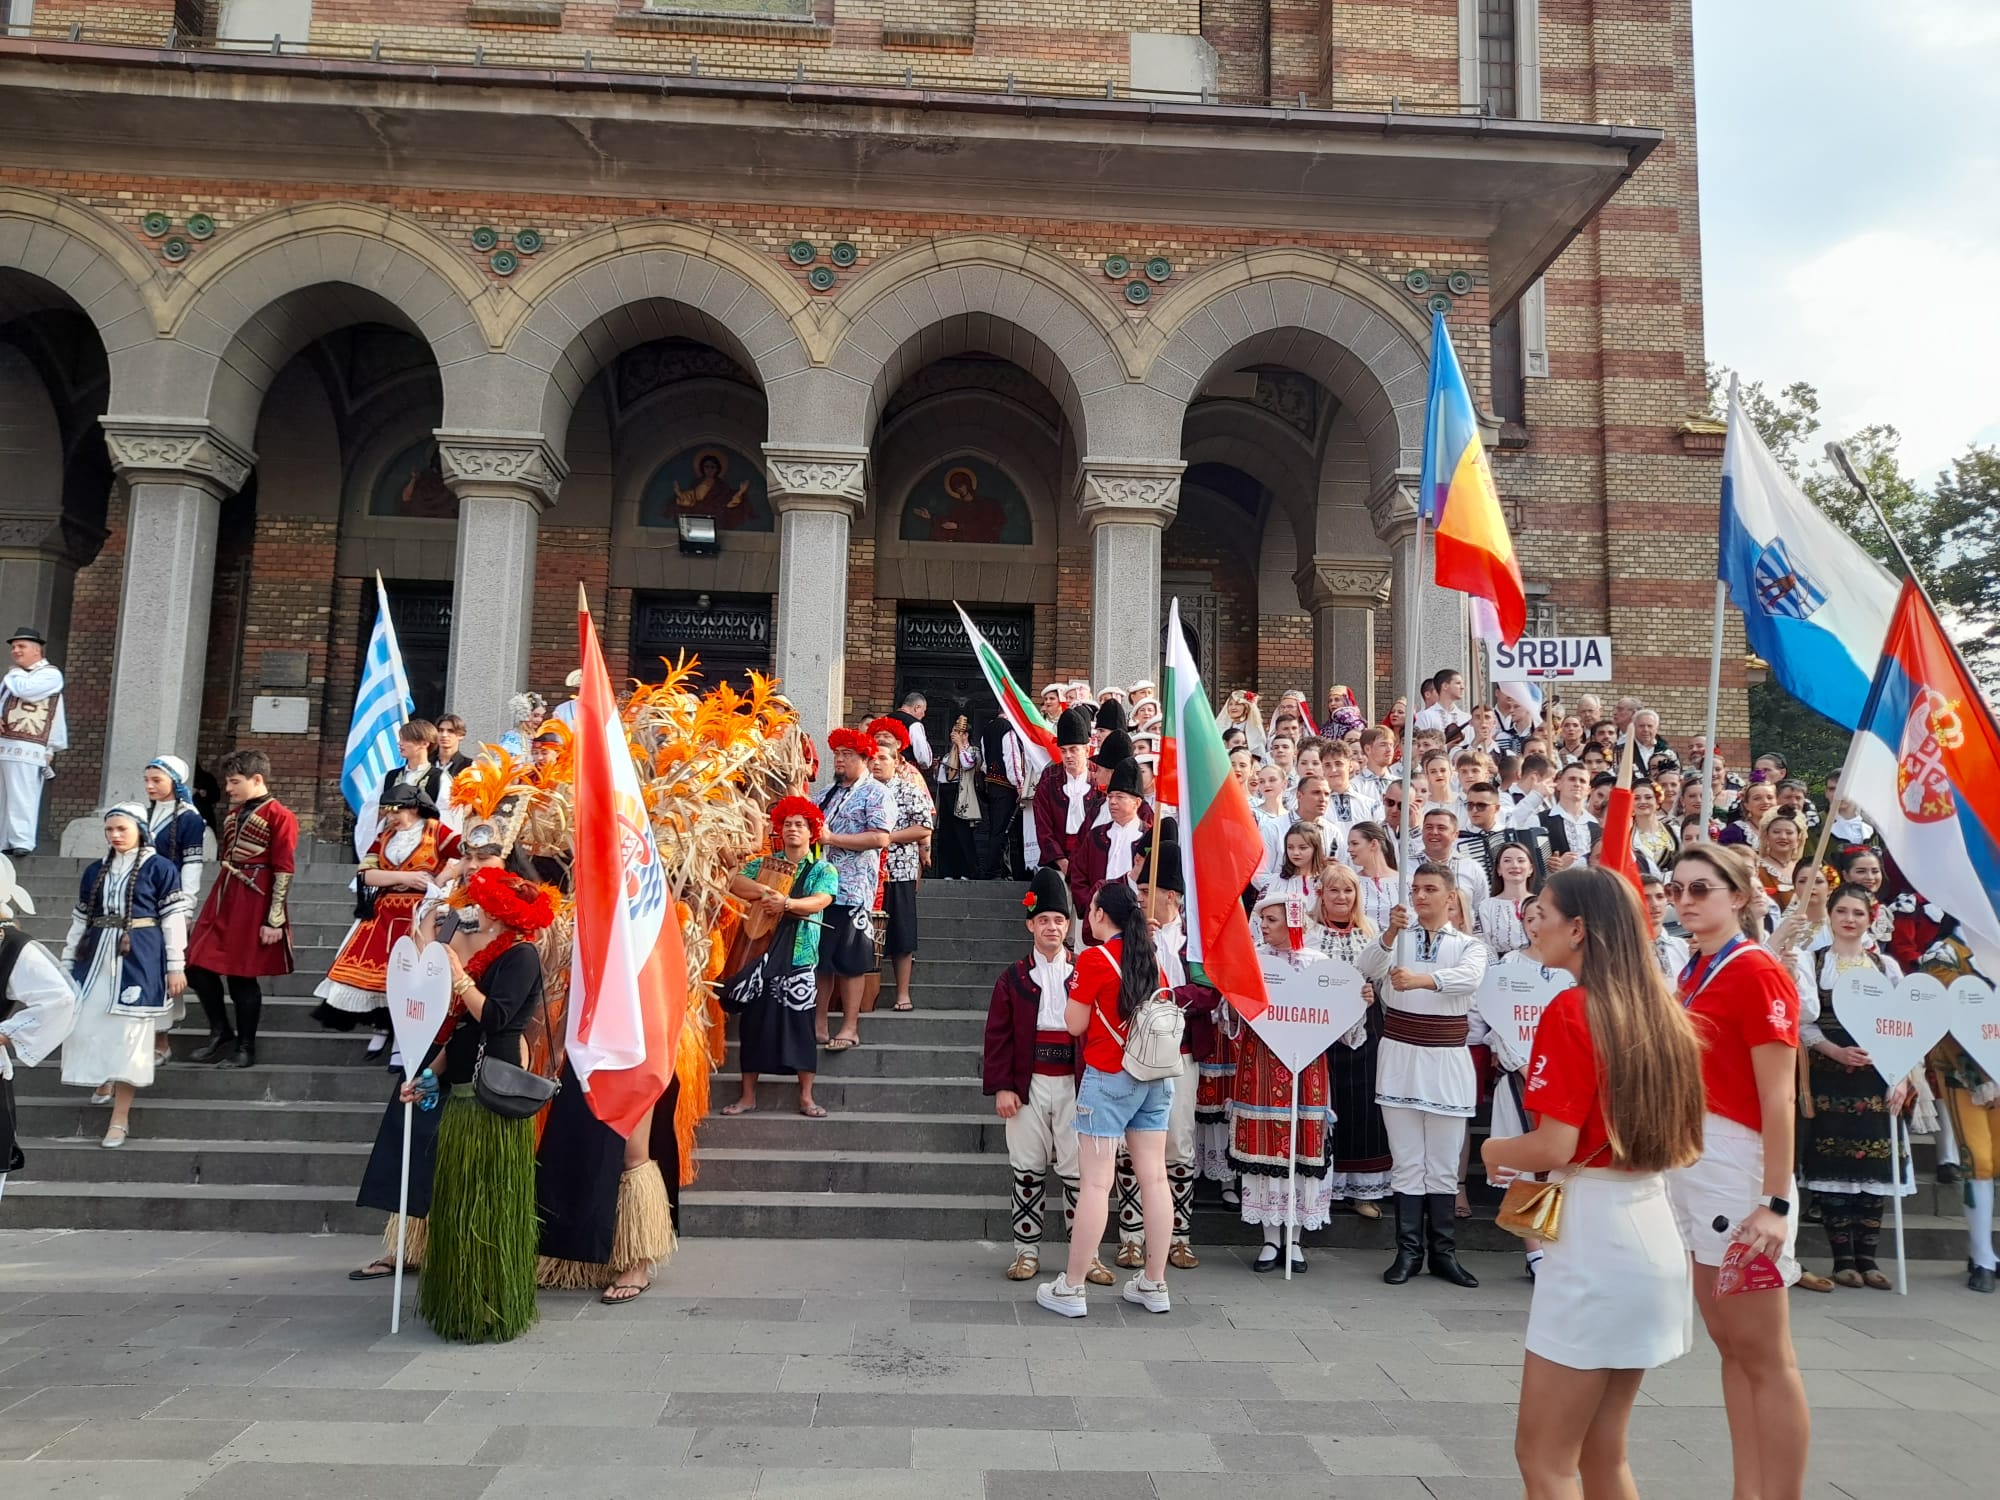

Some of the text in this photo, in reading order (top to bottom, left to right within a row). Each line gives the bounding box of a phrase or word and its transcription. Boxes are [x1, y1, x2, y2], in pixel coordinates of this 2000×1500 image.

[1496, 640, 1603, 668] SRBIJA
[406, 998, 425, 1021] TAHITI
[1267, 1005, 1330, 1025] BULGARIA
[1876, 1018, 1913, 1037] SERBIA
